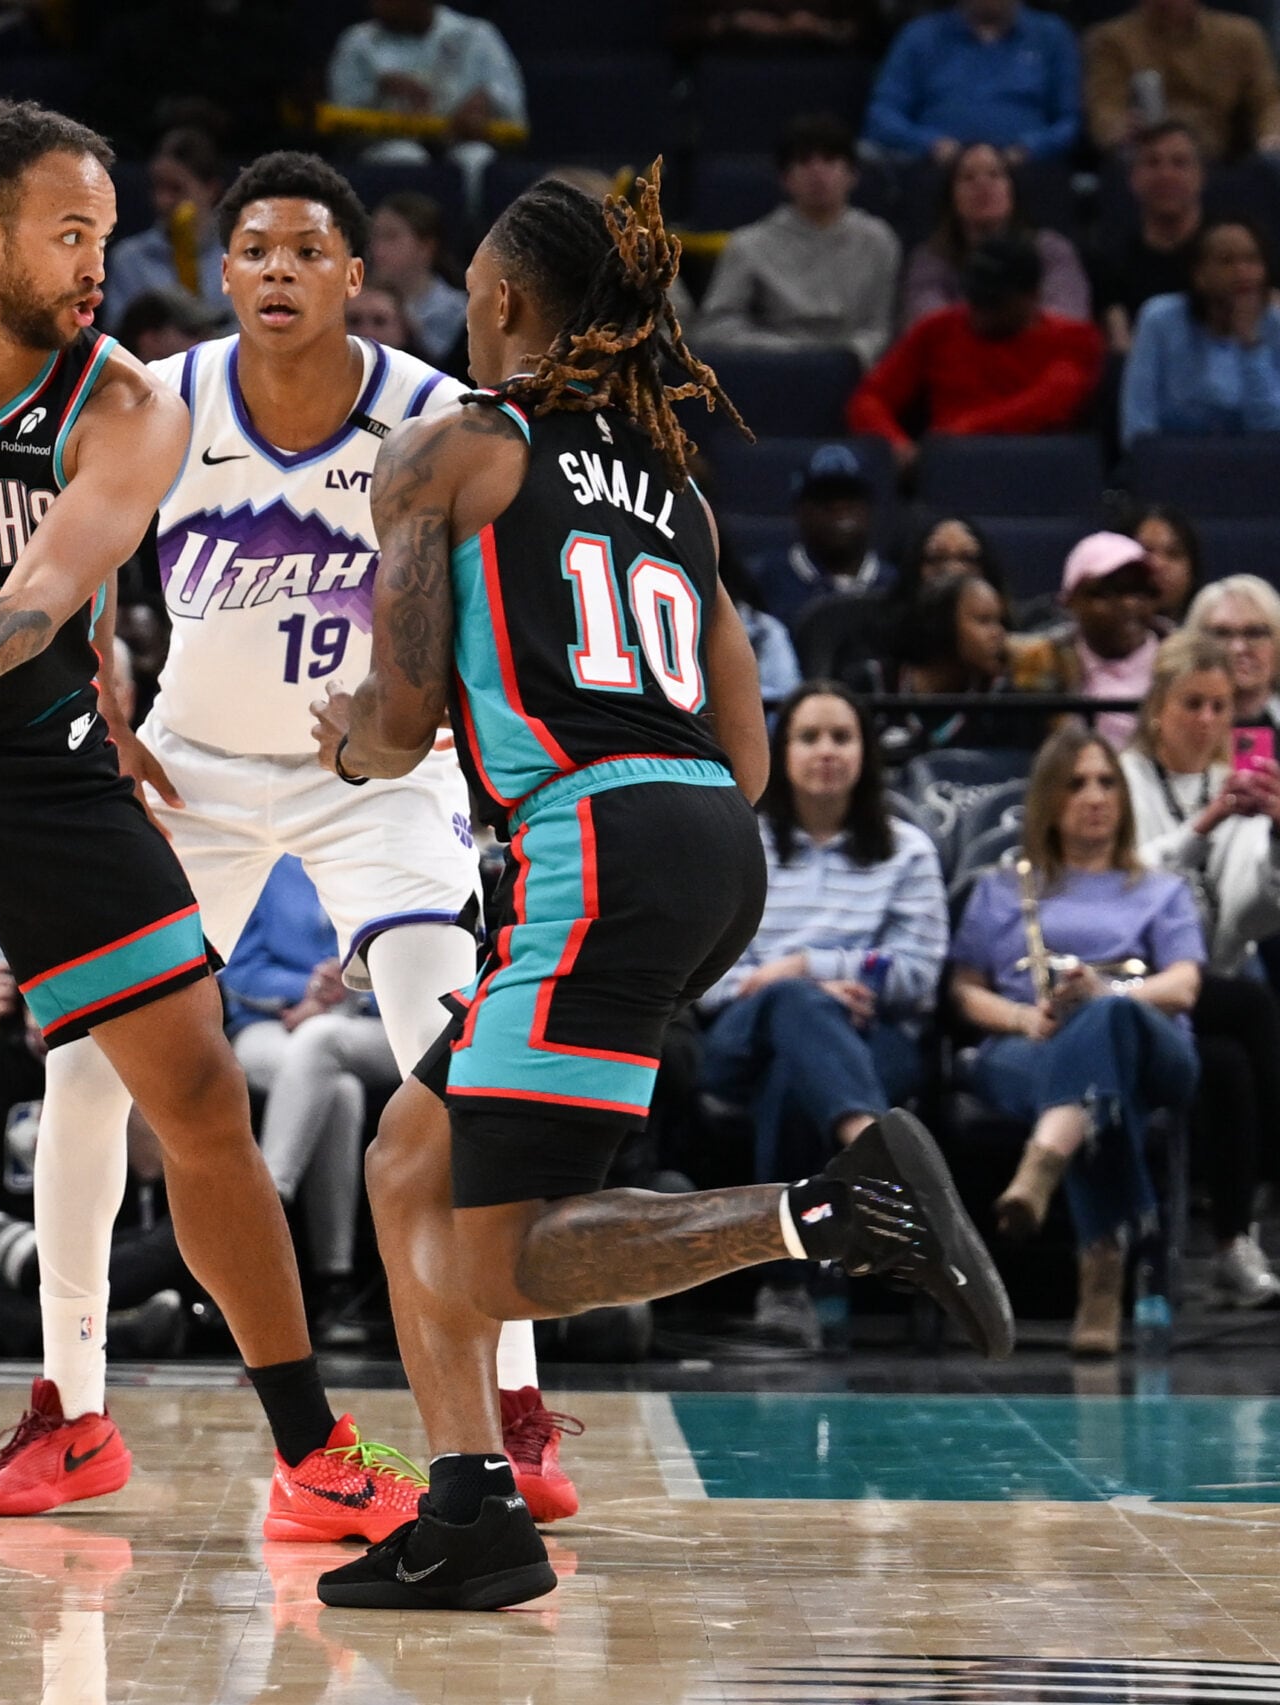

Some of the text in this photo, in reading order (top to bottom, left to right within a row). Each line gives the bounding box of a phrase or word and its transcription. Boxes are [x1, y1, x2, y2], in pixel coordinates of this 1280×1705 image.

[1, 440, 51, 456] Robinhood
[325, 469, 373, 493] LVT
[558, 450, 676, 540] SMALL
[166, 531, 379, 619] UTAH
[278, 612, 351, 685] 19
[561, 529, 707, 714] 10
